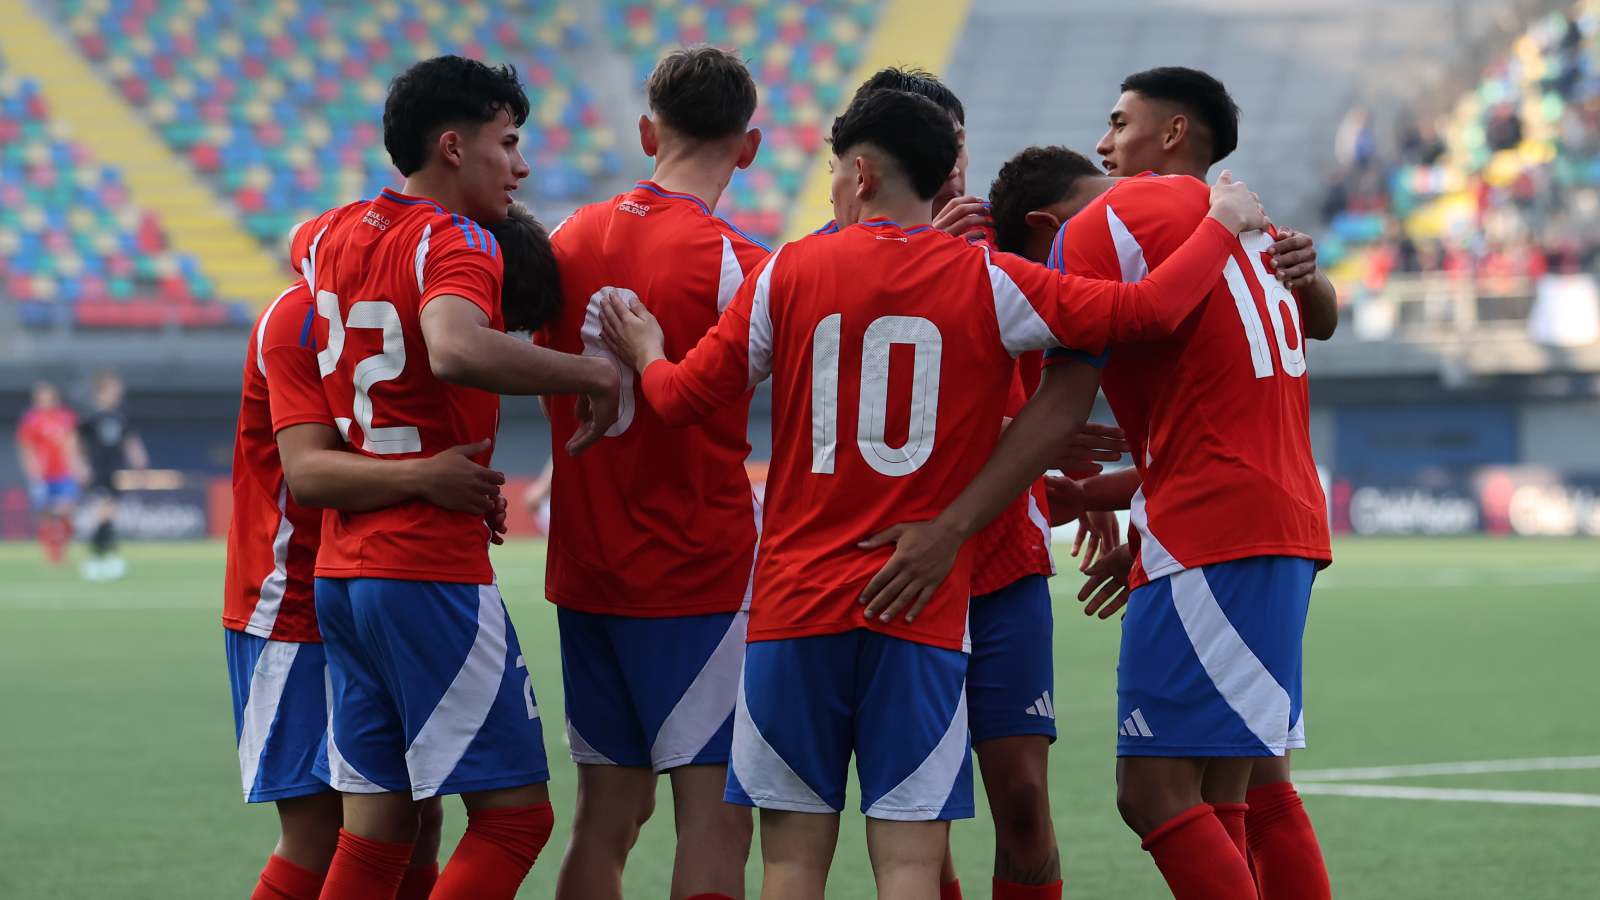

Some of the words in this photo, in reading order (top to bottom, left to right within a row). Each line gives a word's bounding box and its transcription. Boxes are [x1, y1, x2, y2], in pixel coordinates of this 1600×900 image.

[316, 290, 422, 454] 22
[1223, 231, 1306, 379] 16
[811, 313, 942, 477] 10
